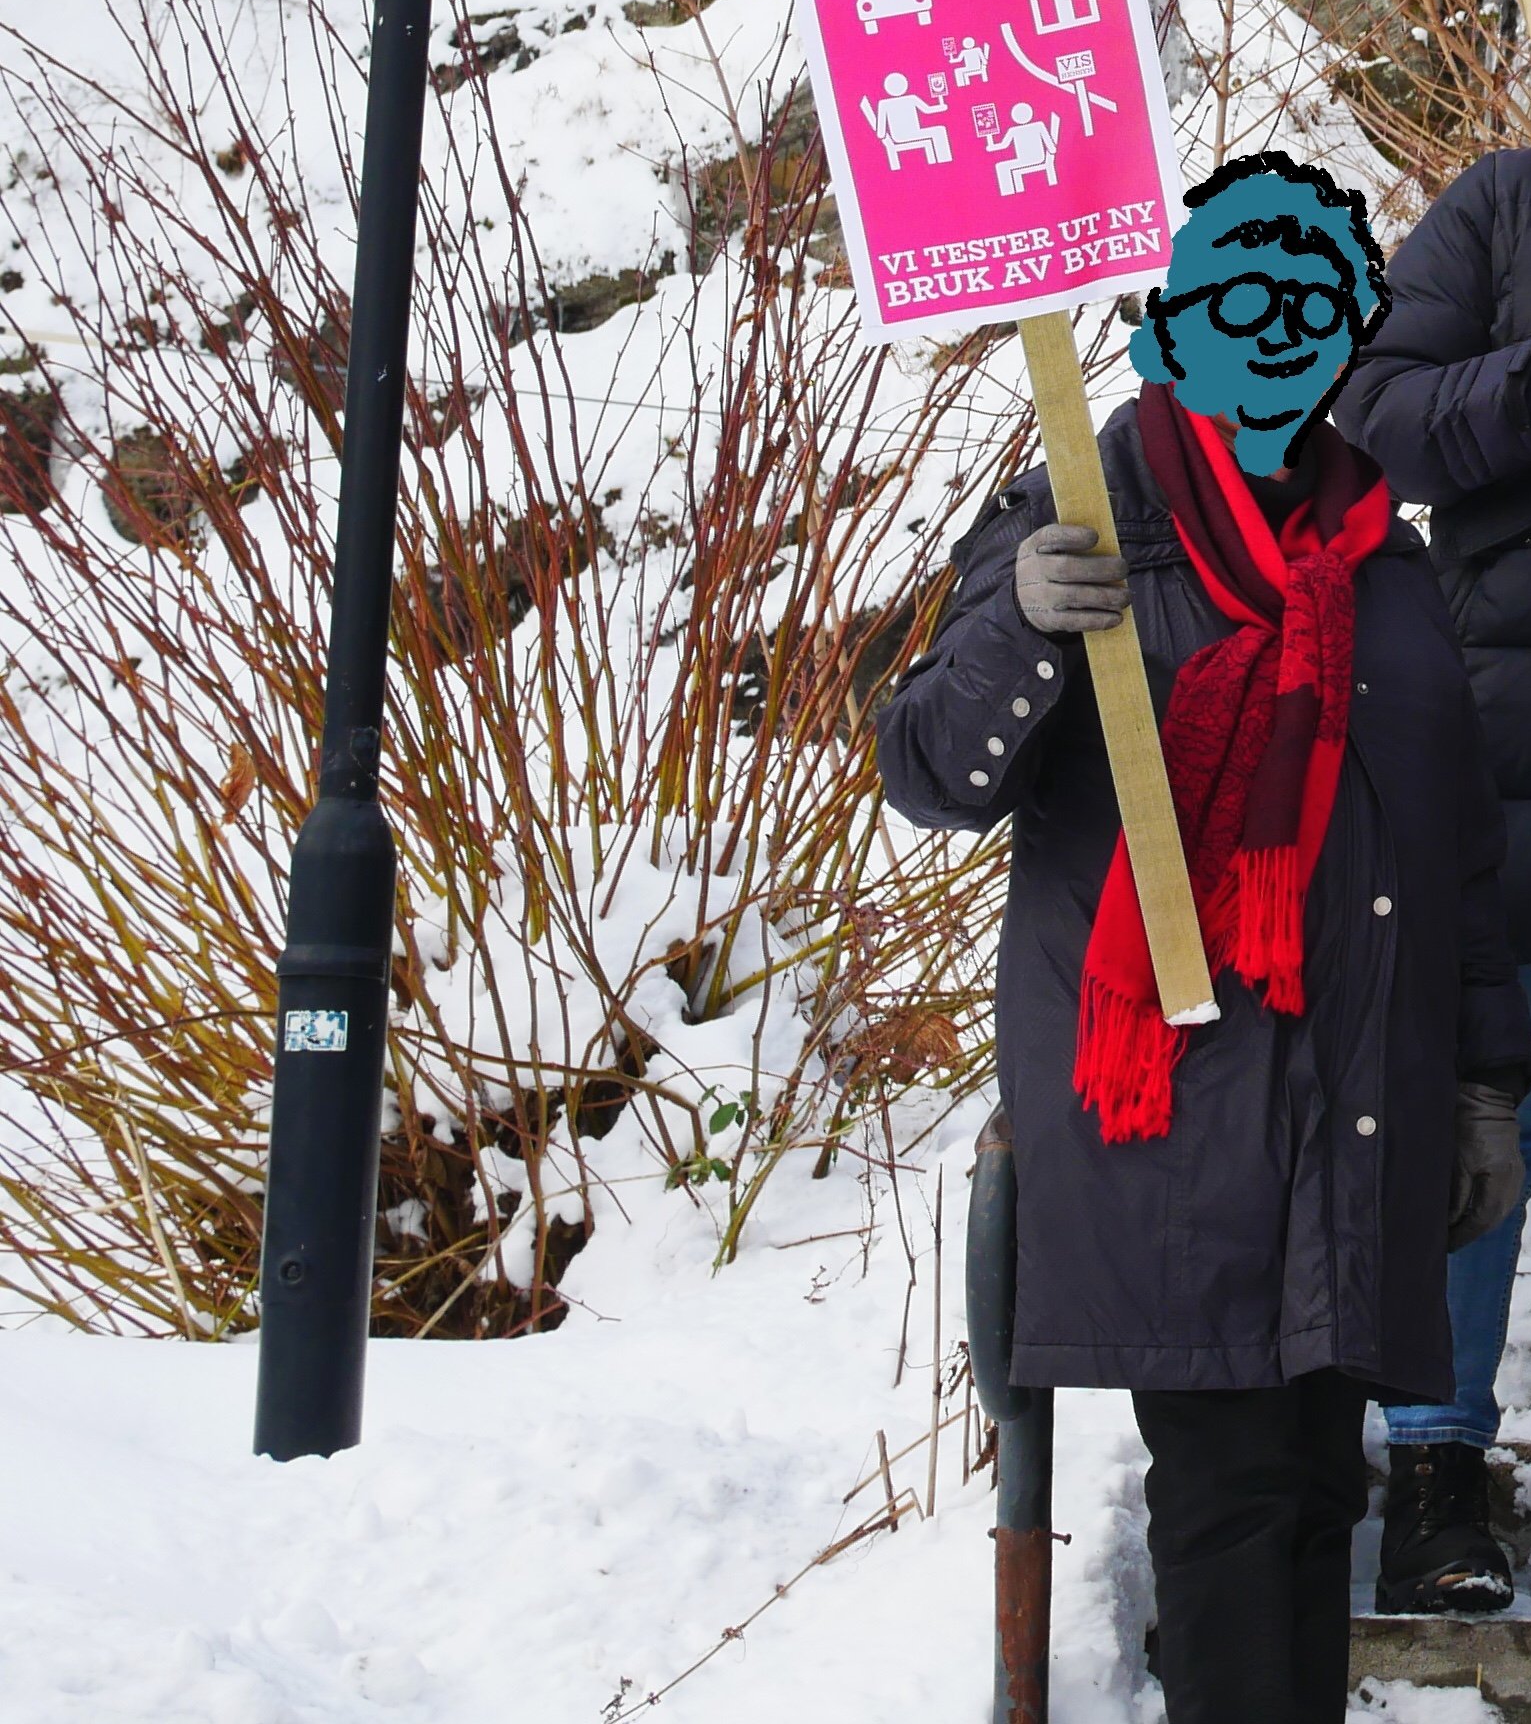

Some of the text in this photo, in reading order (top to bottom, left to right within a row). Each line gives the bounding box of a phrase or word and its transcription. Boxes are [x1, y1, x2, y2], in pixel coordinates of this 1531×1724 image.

[1059, 54, 1092, 71] VIS
[879, 200, 1156, 274] VI TESTER UT NY
[884, 228, 1161, 307] BRUK AV BYEN
